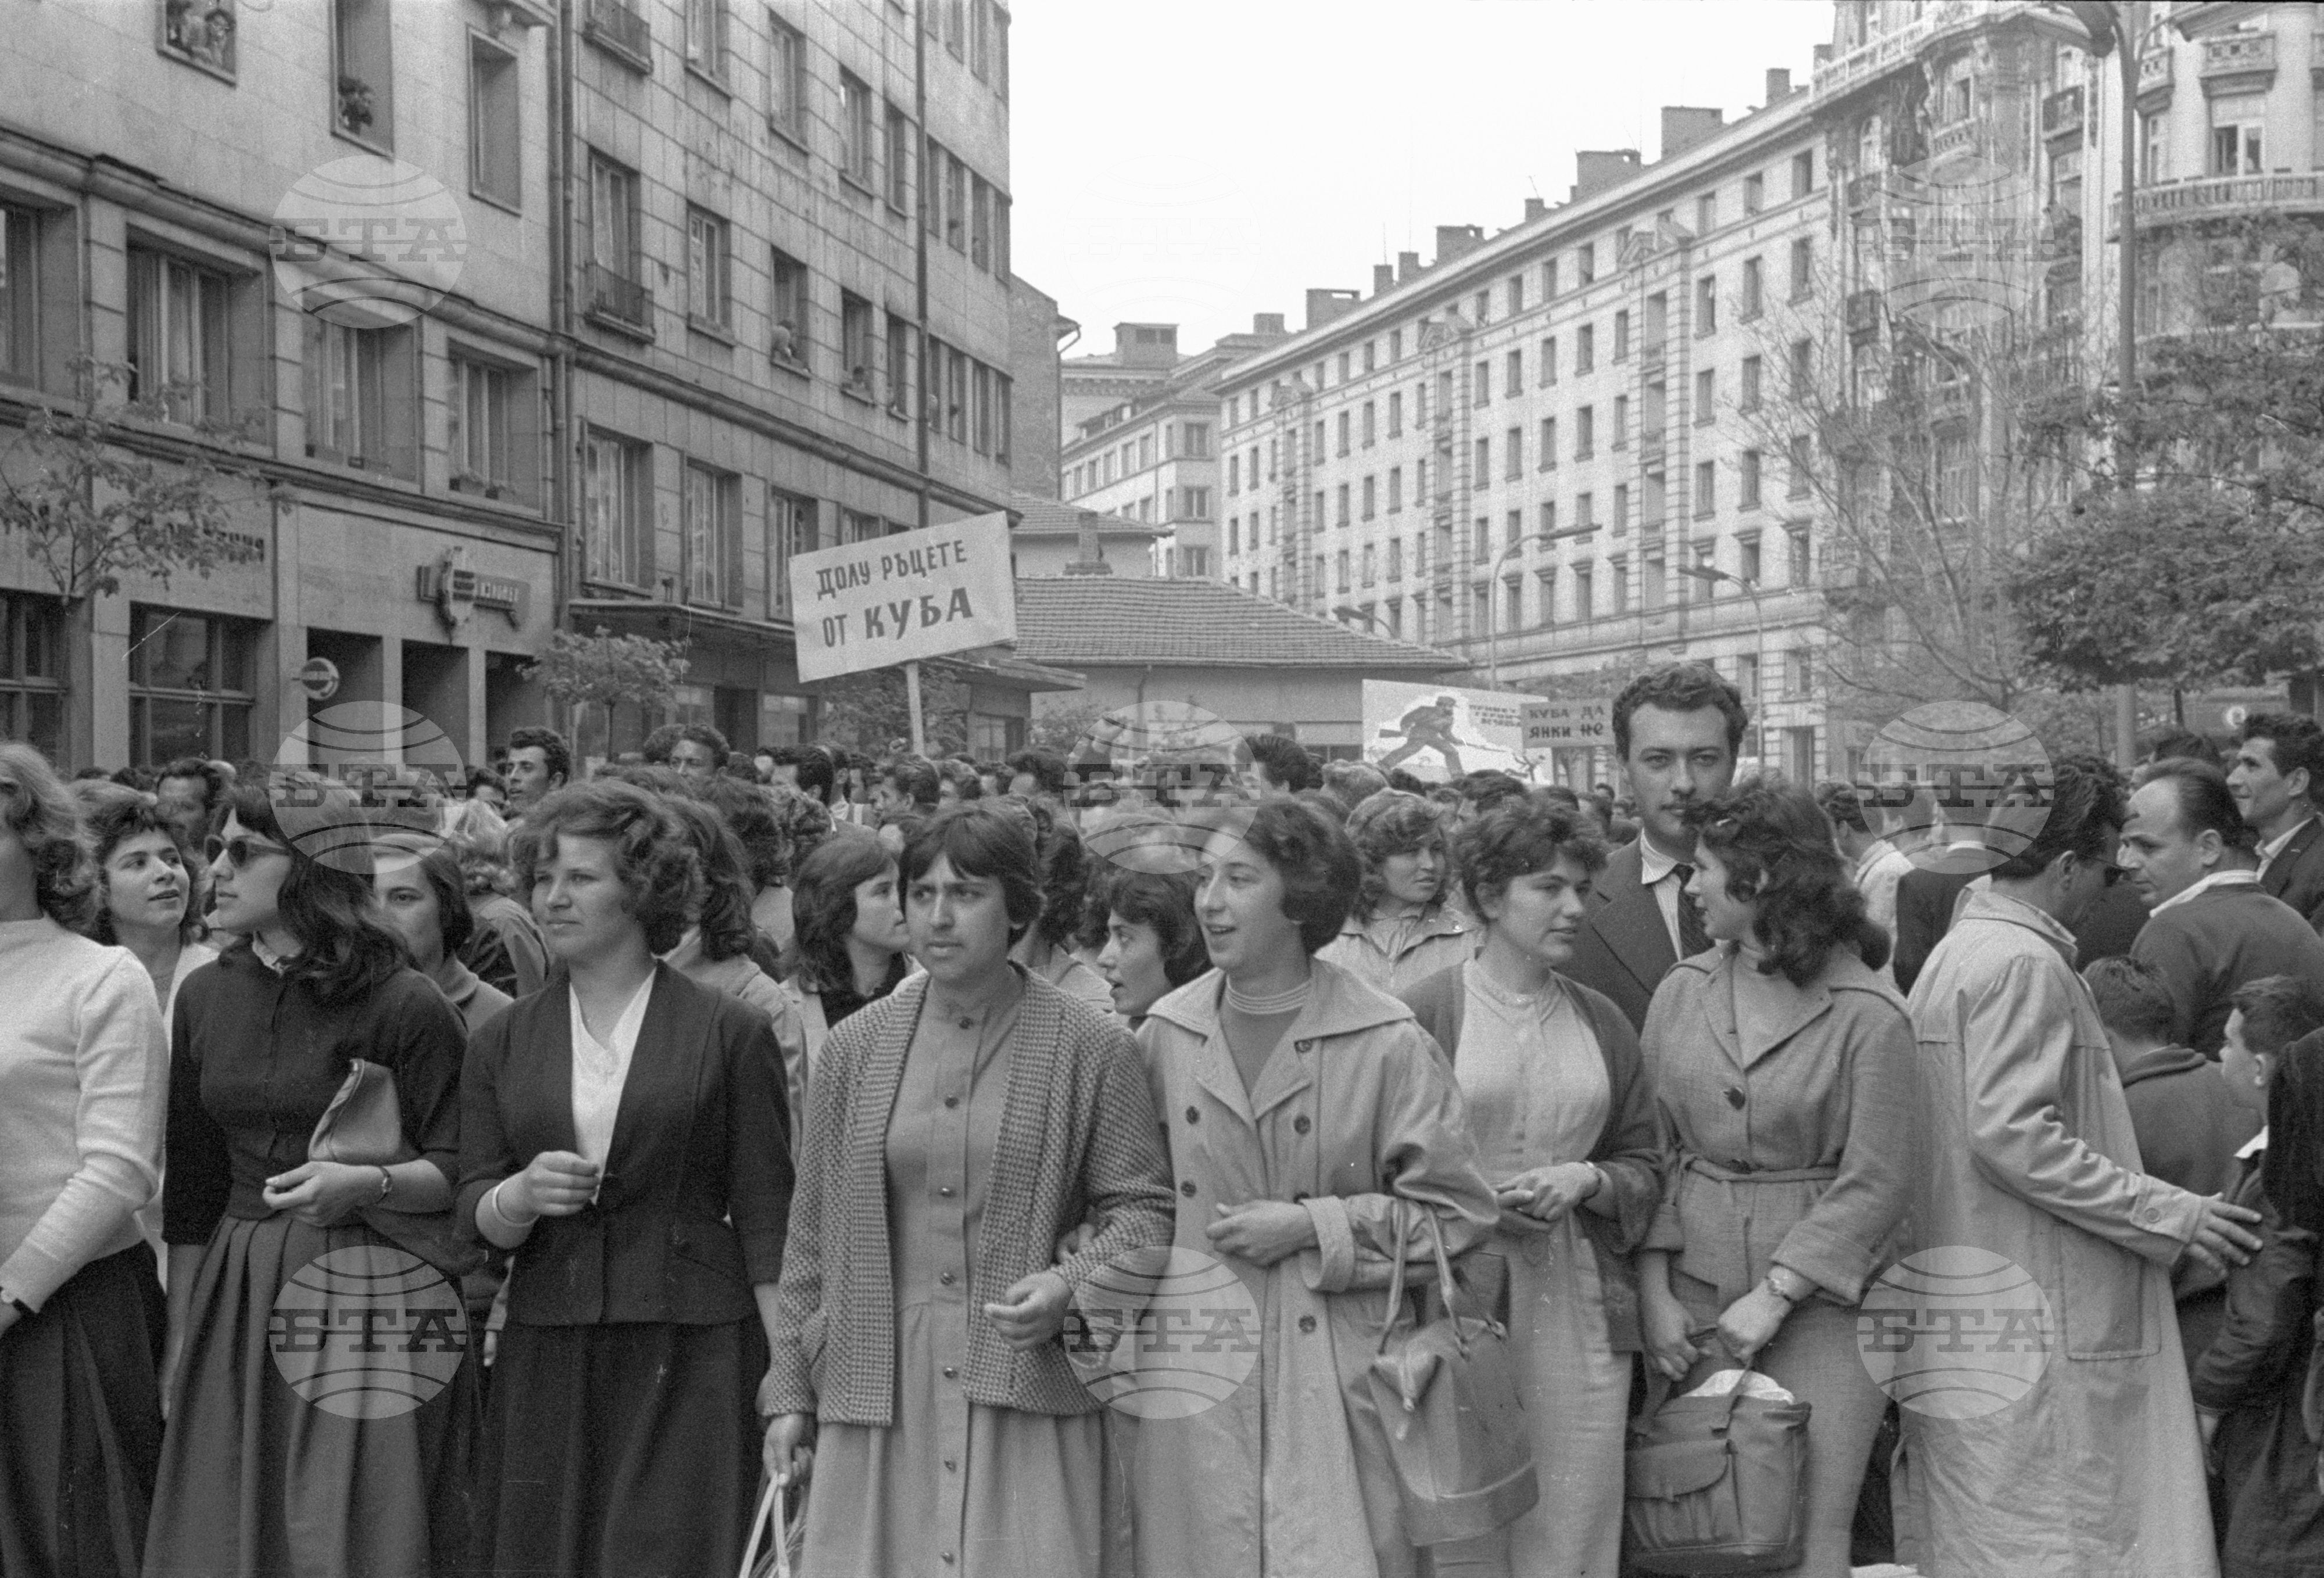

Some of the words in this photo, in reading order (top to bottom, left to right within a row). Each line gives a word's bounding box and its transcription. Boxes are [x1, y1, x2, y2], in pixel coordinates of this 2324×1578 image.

[816, 560, 871, 601] ДОЛУ
[881, 539, 967, 580] РЪЦЕТЕ
[823, 614, 847, 648] ОТ
[864, 586, 973, 640] КУБА
[1529, 709, 1569, 719] КУБА
[1580, 705, 1605, 720] ДА
[1529, 726, 1571, 738] ЯНКИ
